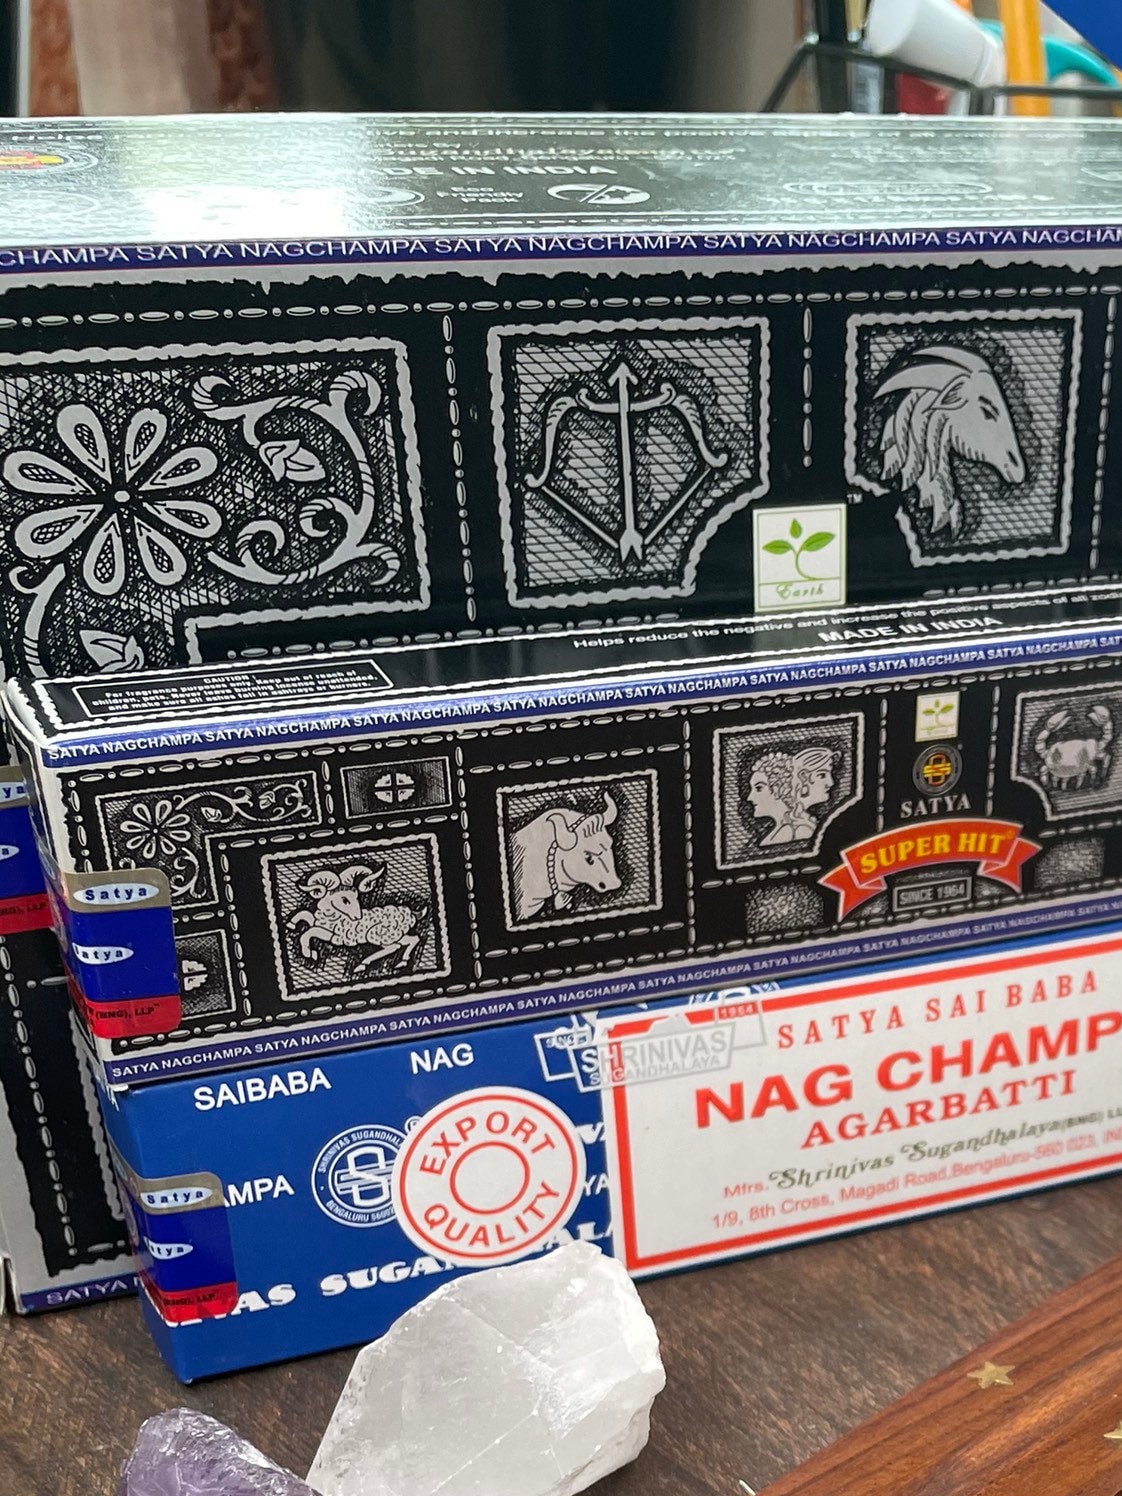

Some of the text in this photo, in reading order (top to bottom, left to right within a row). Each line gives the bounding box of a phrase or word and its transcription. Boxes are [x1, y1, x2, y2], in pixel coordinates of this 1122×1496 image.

[452, 166, 618, 175] IN INDIA
[136, 243, 234, 261] SATYA
[241, 239, 429, 259] NAGCHAMPA
[435, 237, 522, 255] SATYA
[529, 235, 697, 252] NAGCHAMPA
[704, 233, 782, 250] SATYA
[788, 231, 940, 248] NAGCHAMPA
[946, 229, 1017, 245] SATYA
[776, 583, 825, 599] Earth
[573, 637, 625, 648] Helps
[628, 631, 688, 643] reduce
[692, 627, 720, 637] the
[723, 622, 793, 634] negative
[797, 618, 827, 628] and
[829, 612, 898, 625] increase
[901, 608, 927, 618] the
[930, 603, 989, 616] positive
[992, 598, 1050, 609] aspects
[1052, 596, 1068, 604] of
[1070, 595, 1090, 604] all
[817, 616, 1003, 643] MADE IN INDIA
[126, 687, 178, 698] fragrance
[180, 683, 227, 695] purposes
[315, 671, 345, 680] reach
[171, 691, 201, 700] Never
[203, 688, 232, 698] leave
[234, 684, 275, 695] burning
[276, 680, 316, 690] incense
[203, 675, 250, 685] CAUTION
[49, 637, 1098, 760] SATYA NAGCHAMPA SATYA NAGCHAMPA SATYA NAGCHAMPA SATYA NAGCHAMPA SATYA NAGCHAMPA SATYA NAGCHAMPA SATYA NAGCHAMPA SATYA NAGCHAMPA
[131, 701, 161, 709] make
[189, 696, 203, 704] all
[205, 694, 236, 703] ashes
[238, 691, 256, 700] fall
[271, 686, 313, 697] ashtrays
[900, 793, 972, 818] SATYA
[860, 832, 1006, 874] SUPER HIT
[85, 887, 147, 901] Satya
[900, 884, 965, 904] SINCE 1964
[112, 927, 971, 1078] SATYA NAGCHAMPA SATYA NAGCHAMPA SATYA NAGCHAMPA SATYA NAGCHAMPA SATYA NAGCHAMPA SATYA NAGCHAMPA SATYA NAGCHAMPA
[777, 970, 1098, 1049] SATYA SAI BABA
[193, 1043, 474, 1111] SAIBABA NAG
[695, 1064, 853, 1129] NAG
[800, 1070, 1078, 1150] AGARBATTI
[419, 1110, 556, 1176] EXPORT
[724, 1181, 769, 1199] Mfrs.
[769, 1157, 895, 1189] Shrinivas
[147, 1189, 204, 1205] Satya
[325, 1199, 370, 1222] BENGALURU
[712, 1211, 743, 1230] 1/9,
[750, 1205, 775, 1221] 8th
[781, 1194, 835, 1215] Cross,
[840, 1176, 900, 1202] Magadi
[423, 1180, 560, 1248] QUALITY
[320, 1255, 458, 1296] SUGA
[46, 1279, 128, 1305] SATYA
